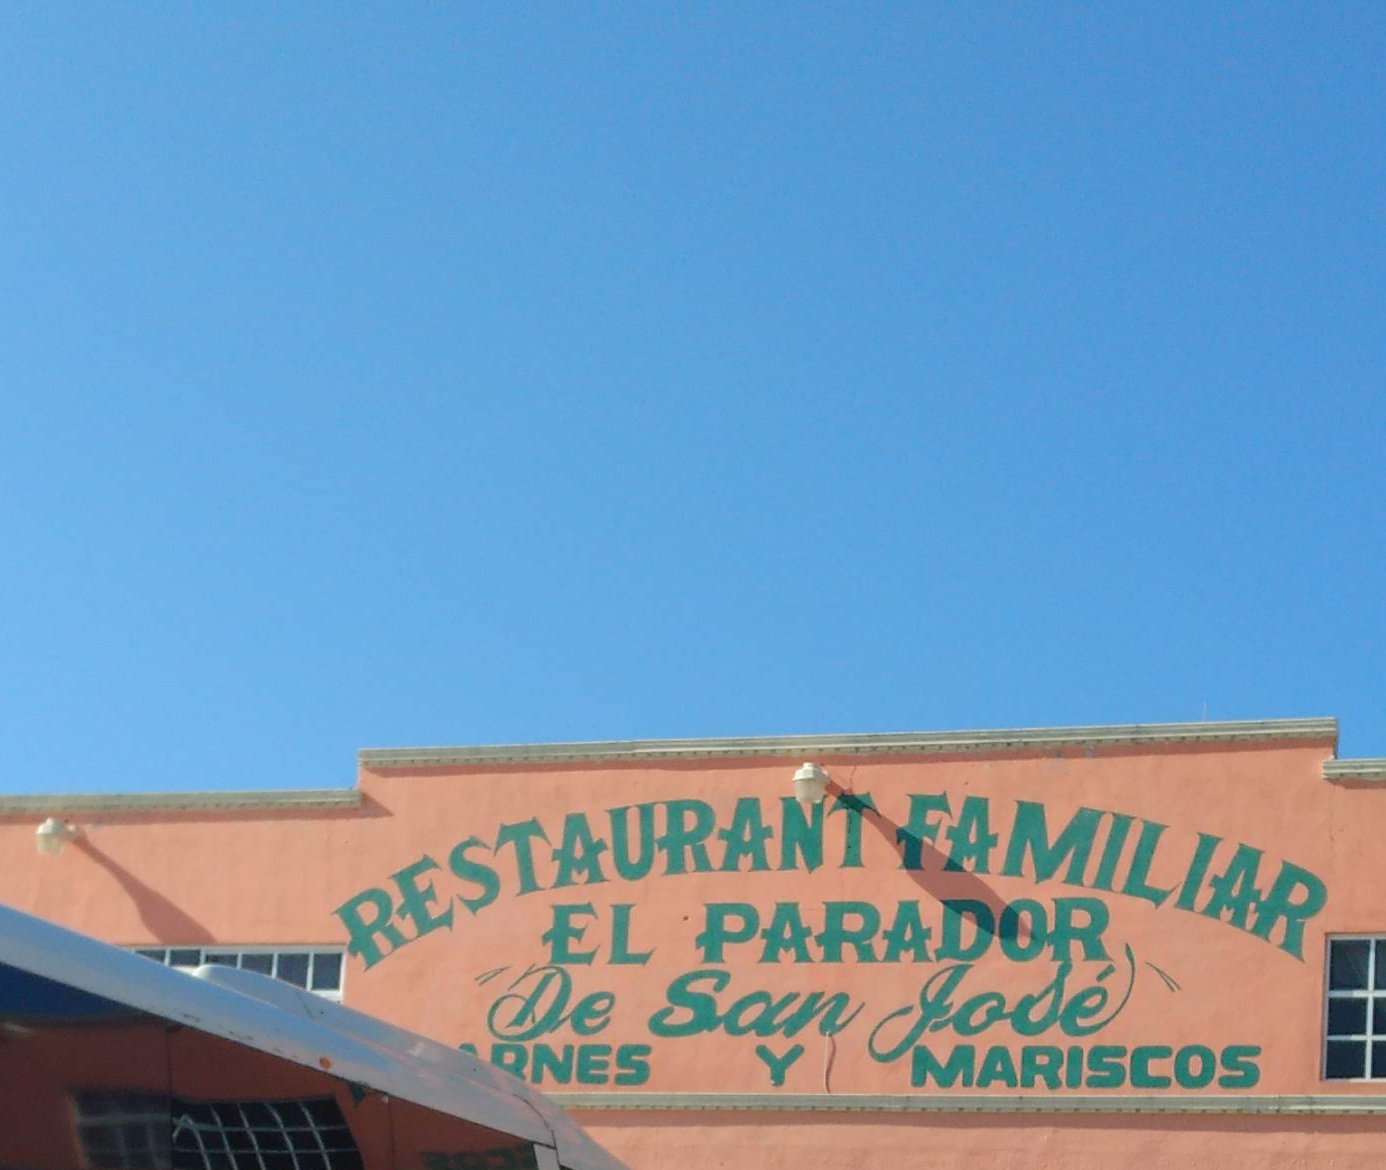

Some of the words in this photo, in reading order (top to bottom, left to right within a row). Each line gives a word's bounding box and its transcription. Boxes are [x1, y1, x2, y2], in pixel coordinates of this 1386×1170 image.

[333, 791, 881, 971] RESTAURANT
[896, 791, 1328, 963] FAMILIAR
[542, 902, 655, 966] EL
[696, 897, 1115, 963] PARADOR
[487, 963, 616, 1042] De
[648, 969, 865, 1038] San
[869, 944, 1136, 1063] José
[459, 1043, 652, 1086] RNES
[755, 1044, 805, 1087] Y
[911, 1045, 1262, 1089] MARISCOS
